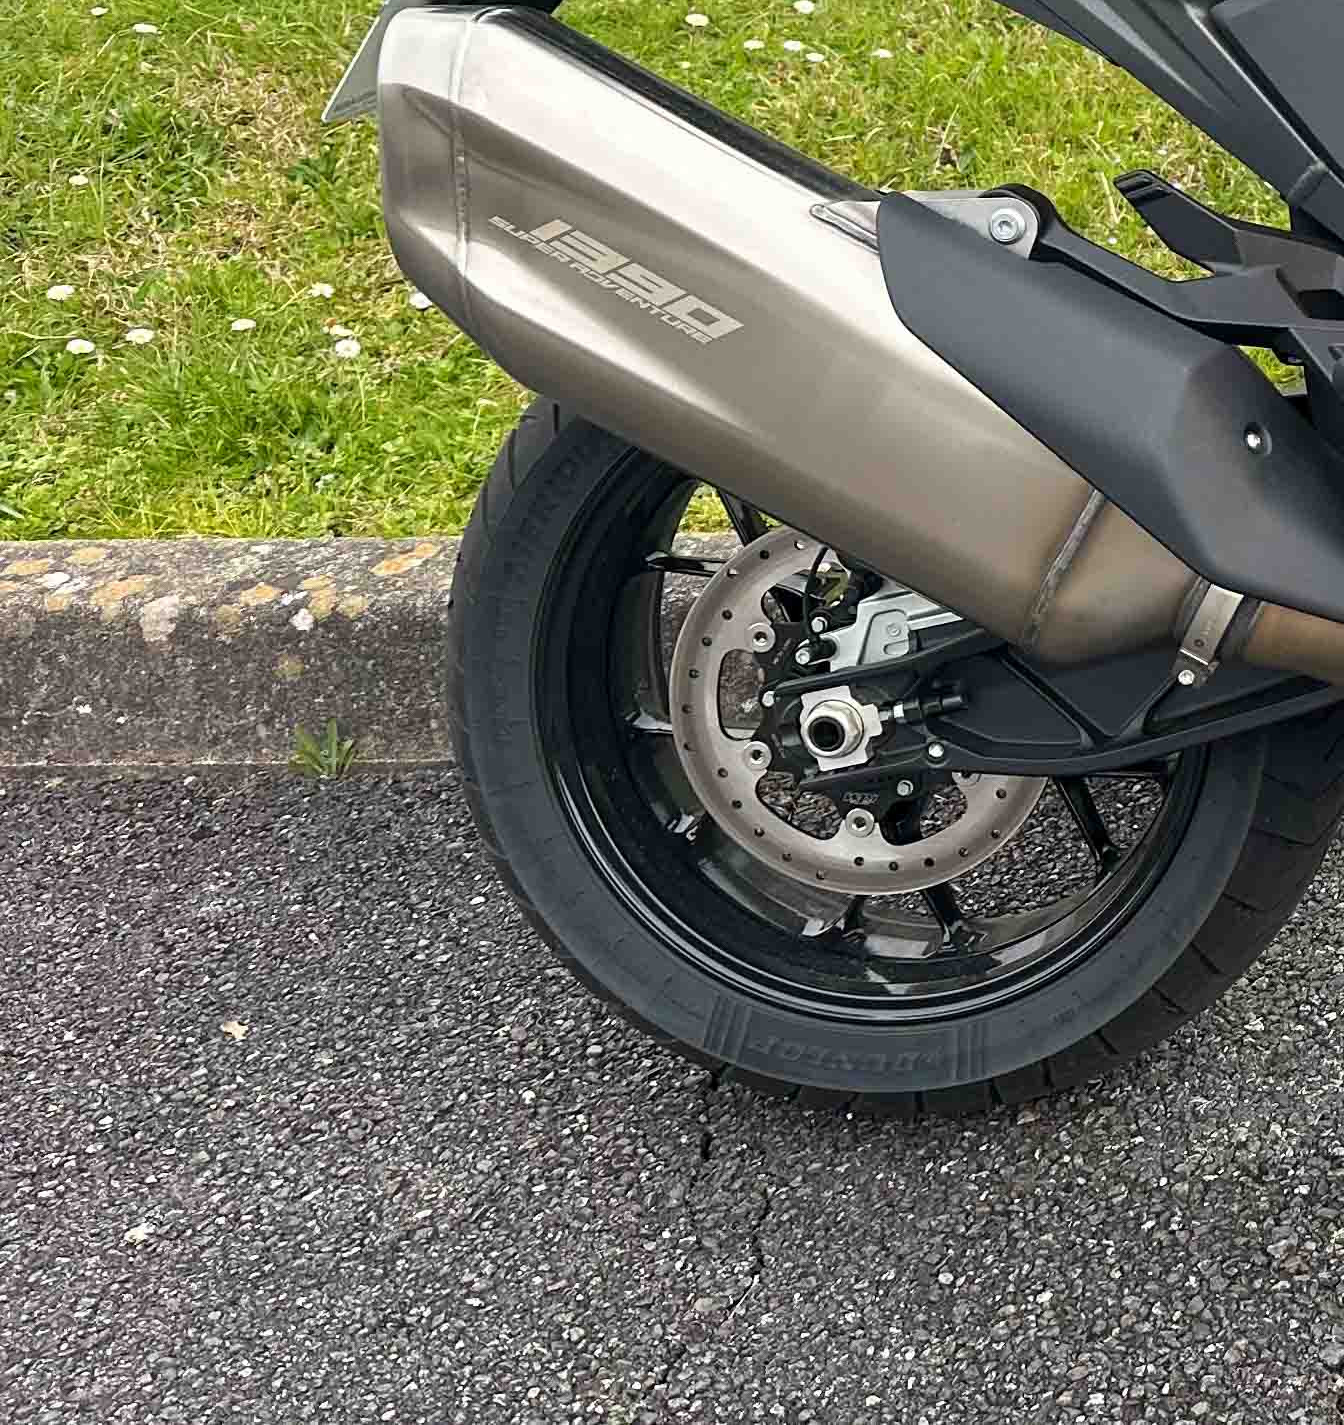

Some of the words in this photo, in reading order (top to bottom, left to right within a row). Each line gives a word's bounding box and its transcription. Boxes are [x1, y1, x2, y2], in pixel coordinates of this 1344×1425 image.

[488, 215, 570, 264] SUPER
[569, 260, 713, 345] ADVENTURE
[528, 218, 745, 340] 1390
